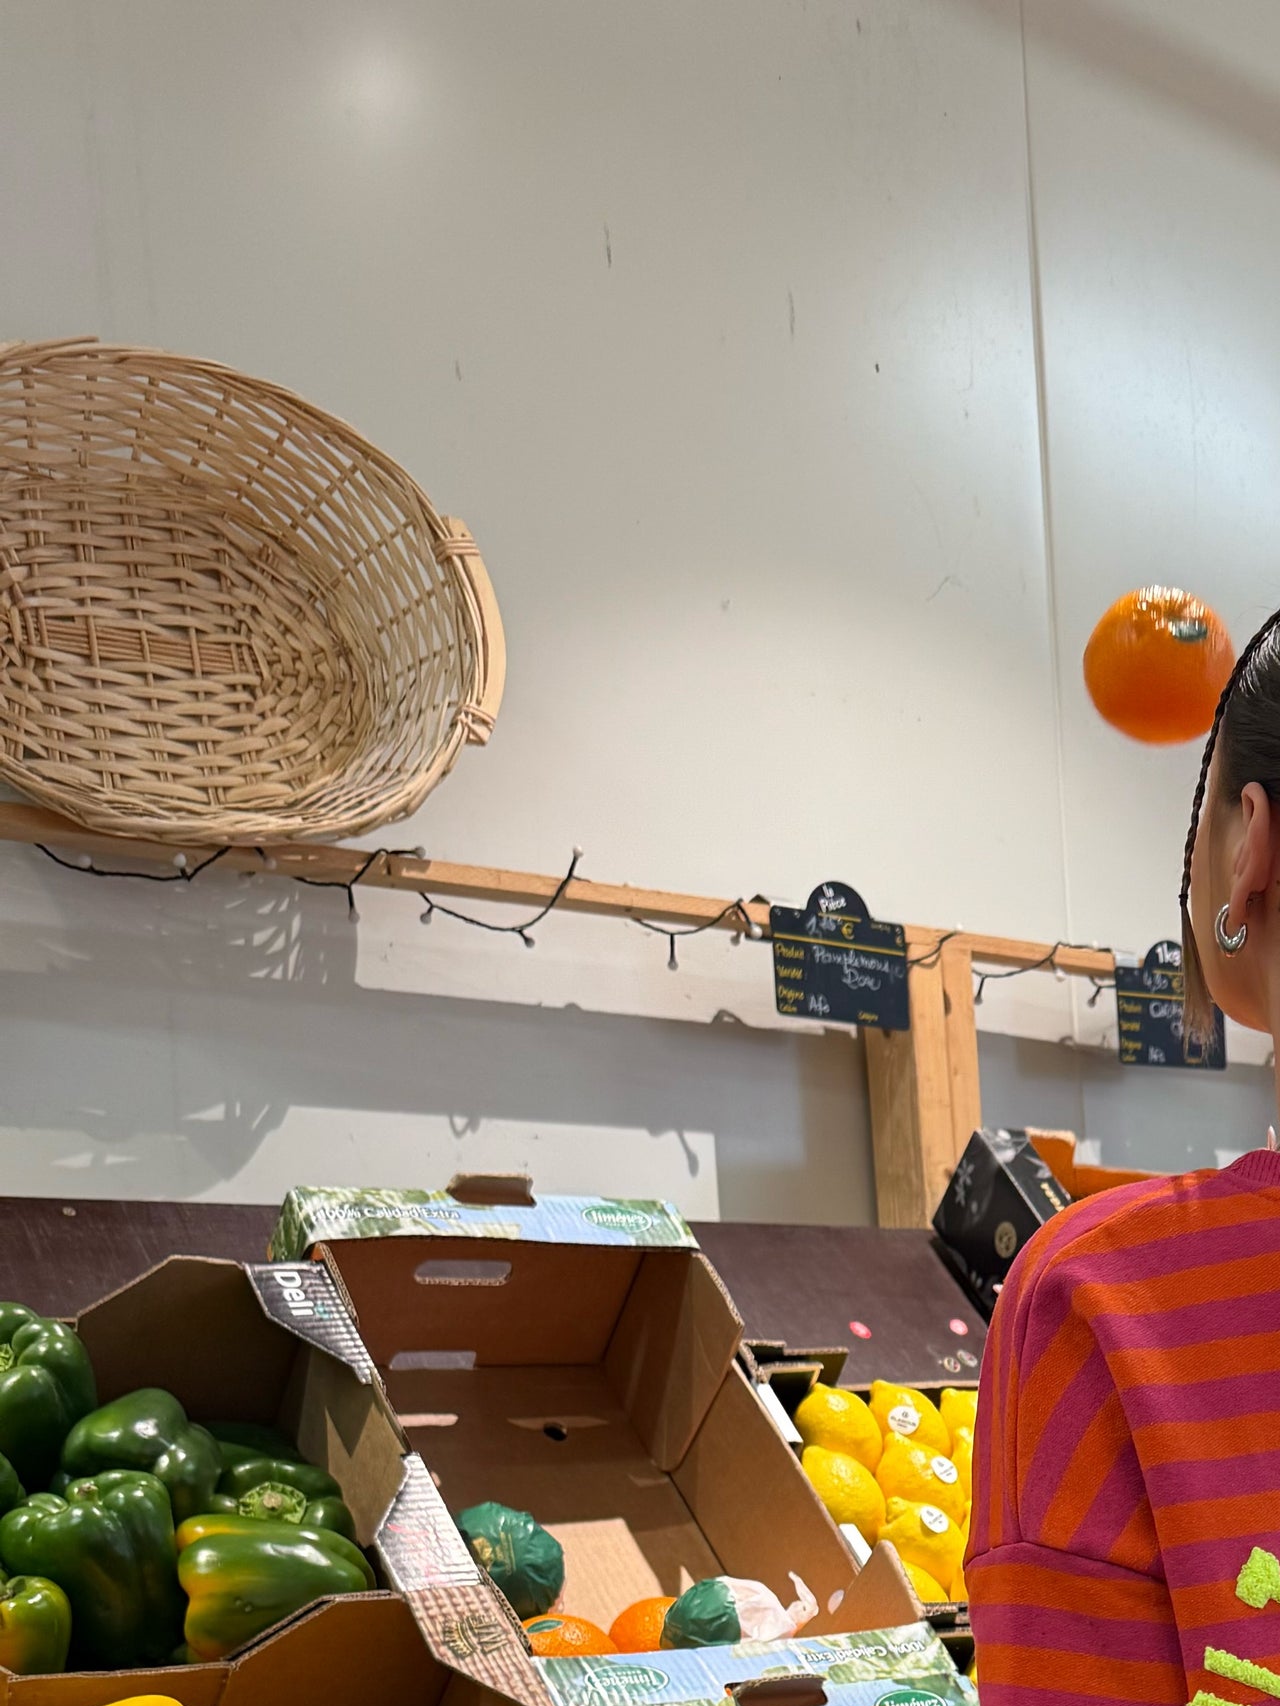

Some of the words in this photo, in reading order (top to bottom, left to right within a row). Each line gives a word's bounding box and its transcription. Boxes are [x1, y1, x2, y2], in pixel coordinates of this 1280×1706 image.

[363, 1205, 421, 1219] Calidad
[423, 1206, 461, 1220] Extra
[273, 1271, 315, 1317] Deli
[804, 1651, 835, 1663] Extr
[836, 1644, 888, 1659] Calidad
[592, 1670, 659, 1689] Jiméne
